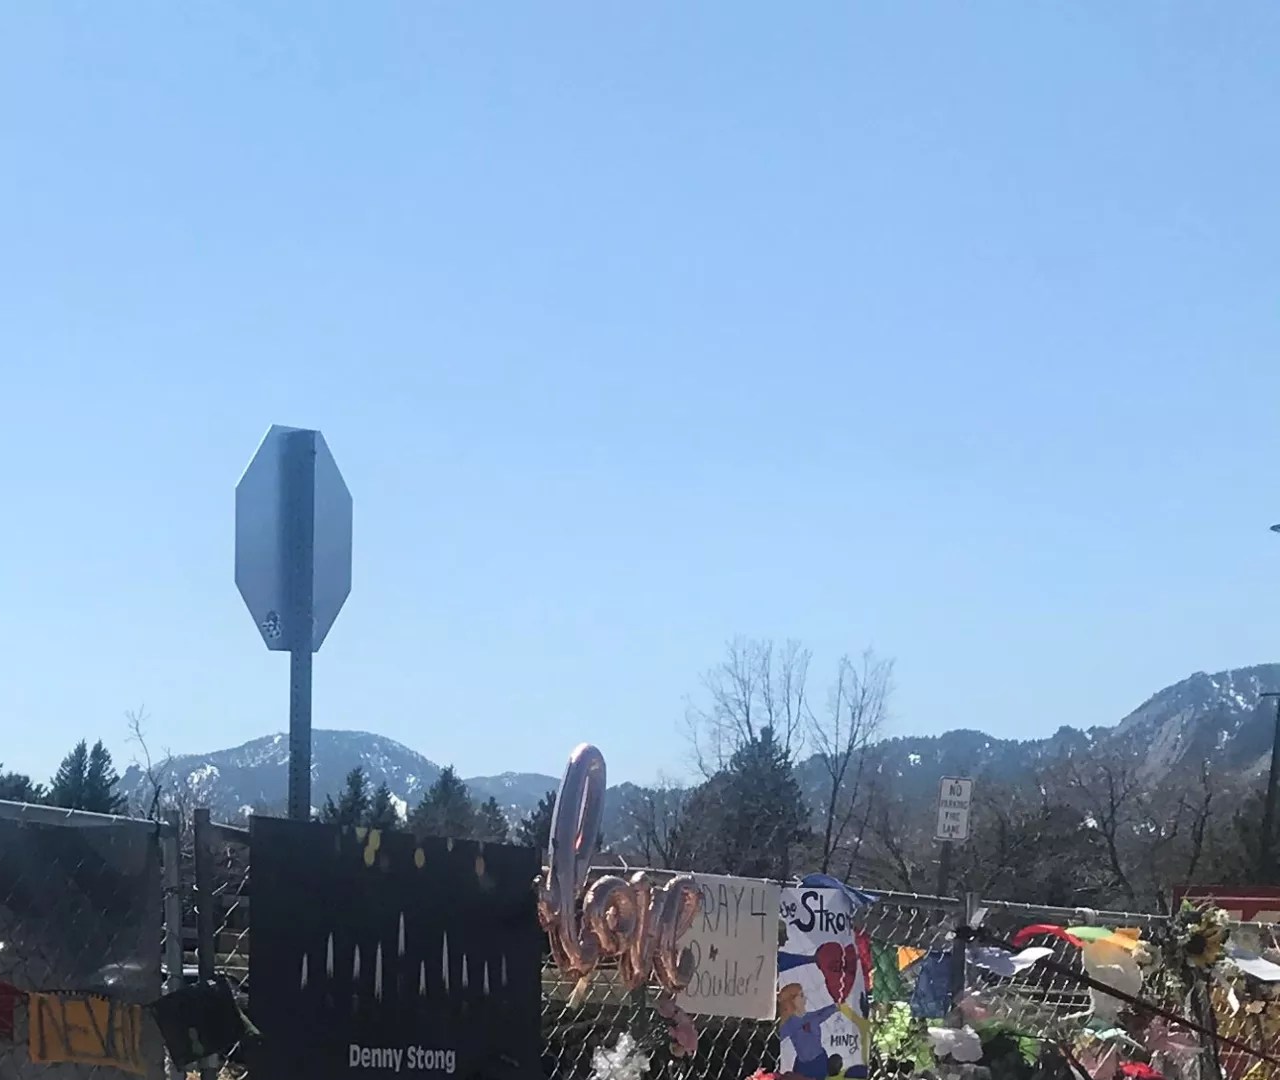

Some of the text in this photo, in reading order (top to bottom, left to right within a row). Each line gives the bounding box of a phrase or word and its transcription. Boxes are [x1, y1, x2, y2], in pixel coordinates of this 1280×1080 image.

[949, 784, 962, 797] NO
[700, 883, 745, 938] RAY
[349, 1043, 457, 1075] Denny Stong
